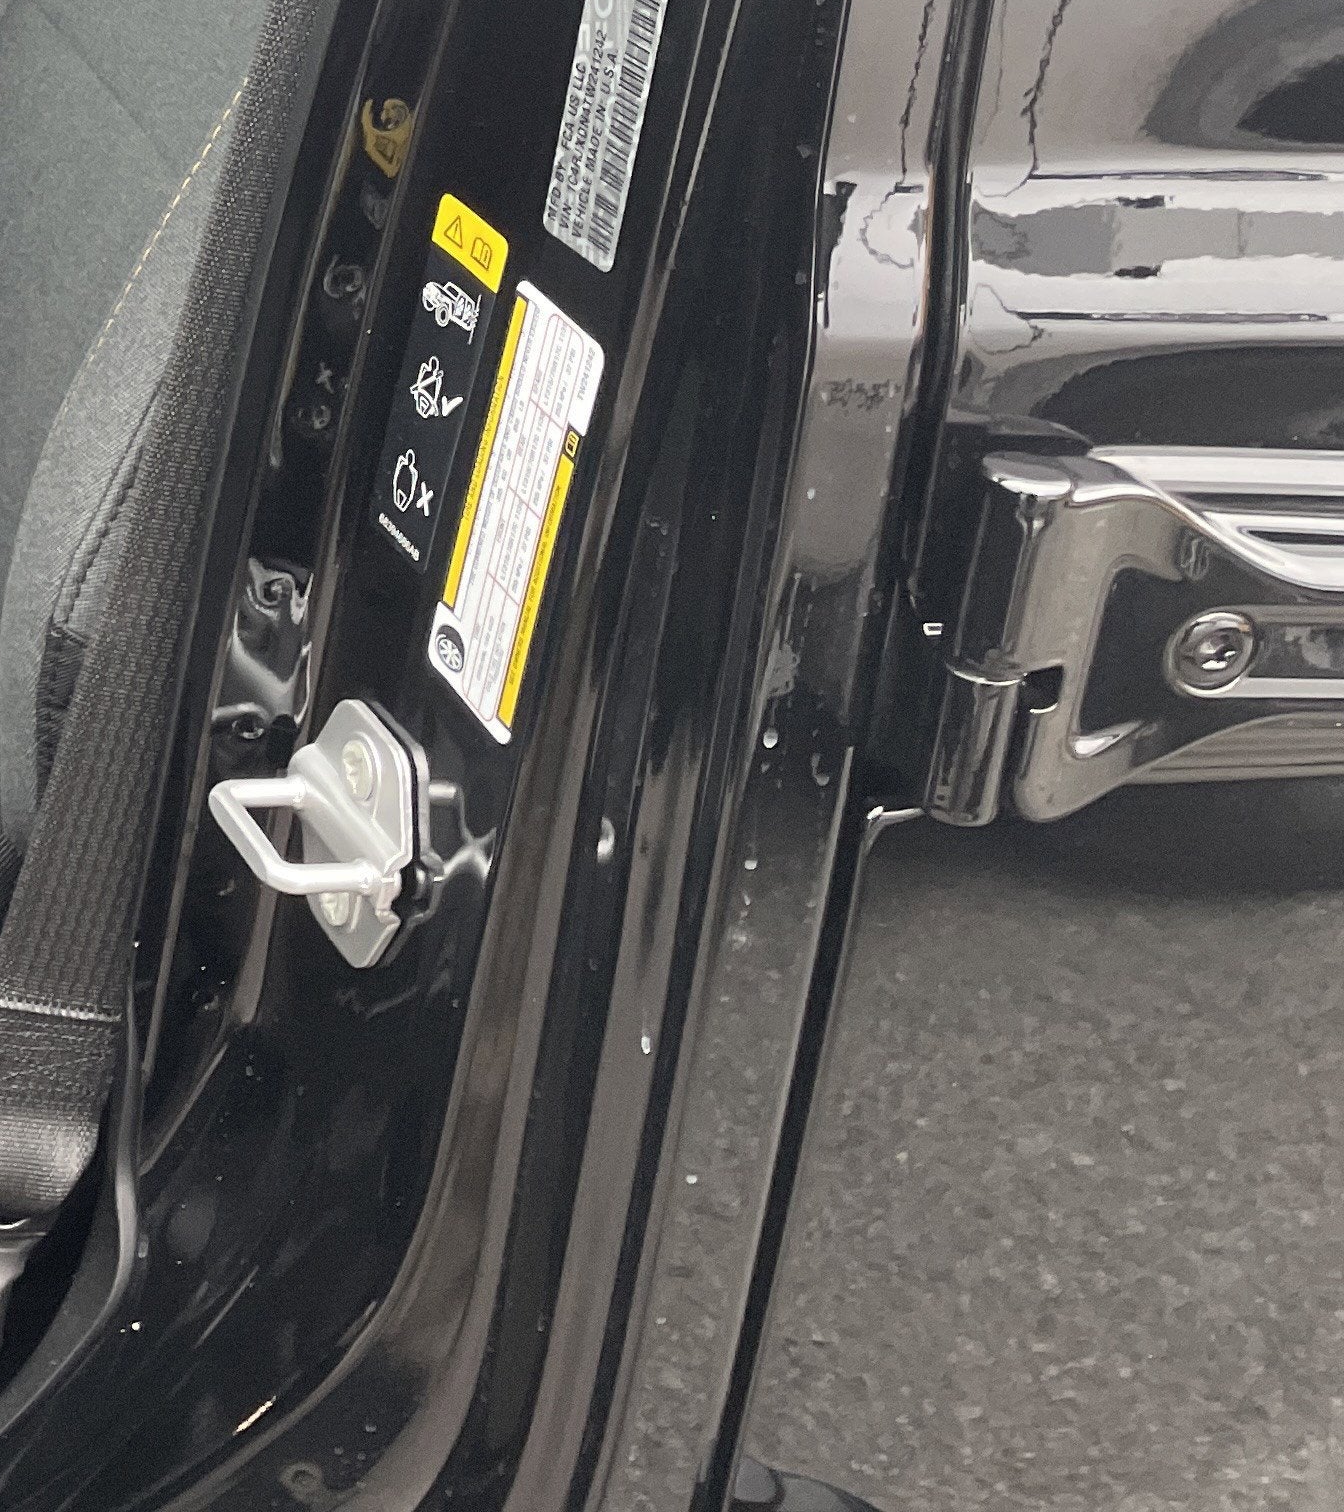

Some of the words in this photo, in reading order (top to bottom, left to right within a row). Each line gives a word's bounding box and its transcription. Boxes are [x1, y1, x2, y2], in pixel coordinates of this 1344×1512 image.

[571, 60, 586, 92] LLC
[567, 93, 580, 118] US
[560, 119, 574, 151] FCA
[571, 174, 592, 241] VEHICLE
[584, 124, 602, 173] MADE
[547, 185, 561, 222] MFD
[577, 346, 596, 401] TW241242
